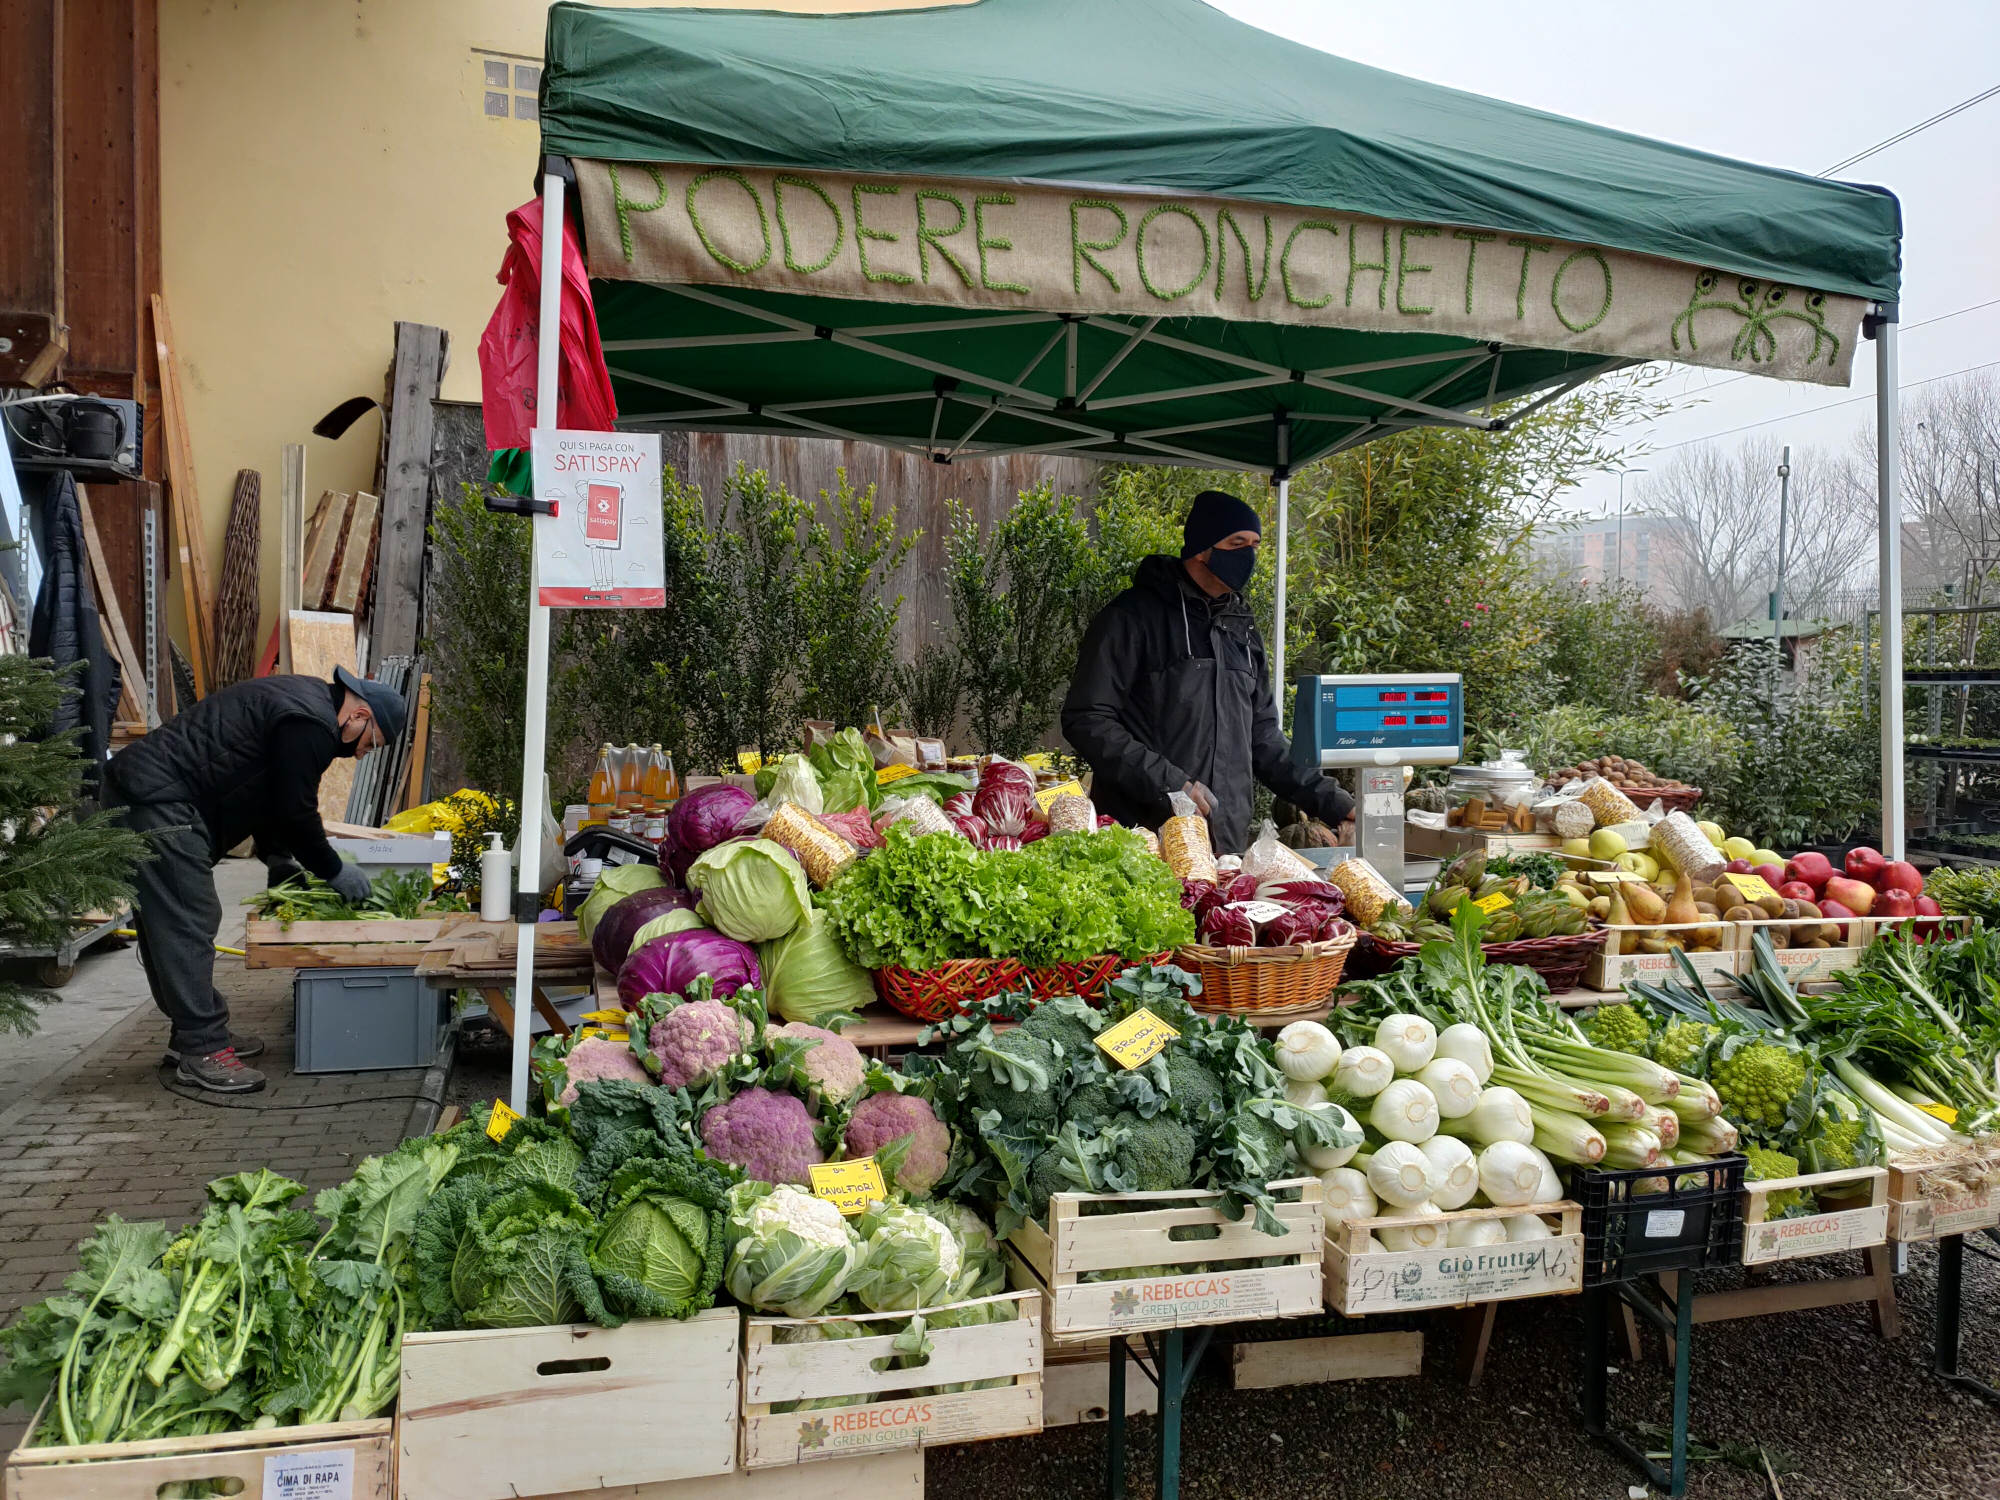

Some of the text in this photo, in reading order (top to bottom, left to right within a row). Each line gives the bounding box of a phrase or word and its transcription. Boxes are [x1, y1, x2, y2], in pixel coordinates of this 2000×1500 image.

[608, 161, 1613, 334] PODERE RONCHETTO
[559, 440, 635, 452] QUI SI PAGA CON
[553, 454, 641, 473] SATISPAY
[589, 516, 617, 527] satispay
[819, 1181, 875, 1196] CAVOLFIORI
[1780, 1217, 1841, 1239] REBECCA'S
[1438, 1251, 1537, 1274] Giò Frutta
[1142, 1277, 1231, 1302] REBECCA'S
[1141, 1301, 1178, 1316] GREEN
[1180, 1300, 1210, 1314] GOLD
[1213, 1298, 1230, 1311] SRL
[832, 1404, 932, 1433] REBECCA'S
[832, 1426, 930, 1448] GREEN GOLD SRL
[277, 1471, 340, 1488] CIMA DI RAPA
